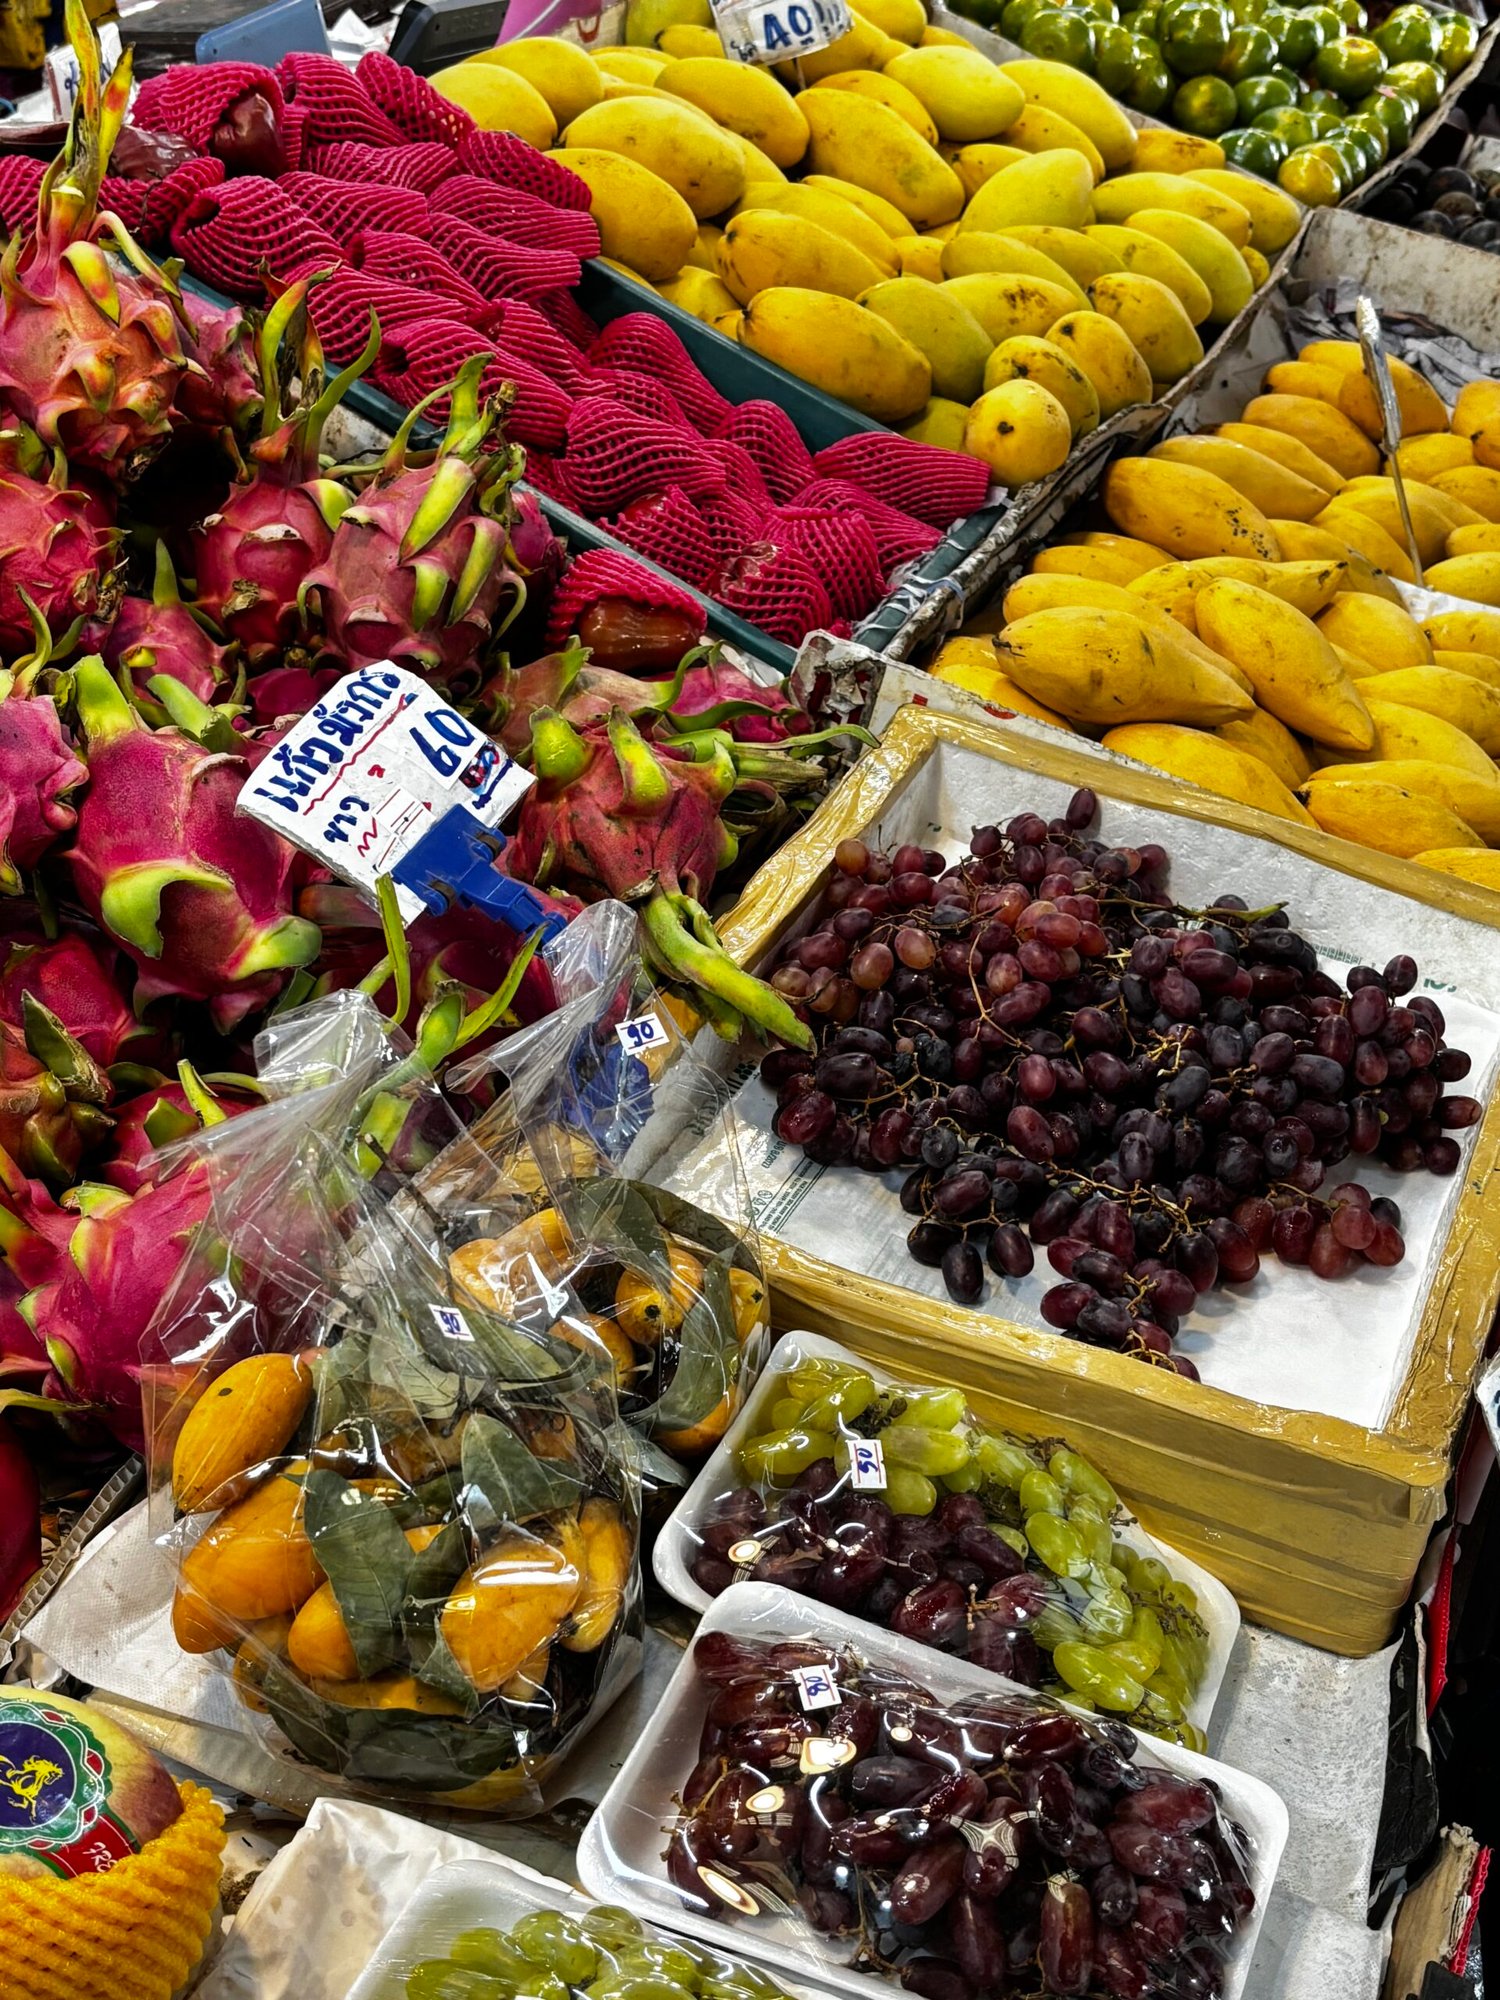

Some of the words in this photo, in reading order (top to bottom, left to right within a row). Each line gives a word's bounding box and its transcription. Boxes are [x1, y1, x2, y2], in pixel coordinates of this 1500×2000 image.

[763, 5, 812, 50] 40
[254, 669, 400, 812] แก้วมังกร
[409, 709, 475, 777] 60
[627, 1022, 654, 1047] 90
[439, 1311, 460, 1335] 90
[856, 1448, 879, 1473] 50
[805, 1676, 830, 1696] 80
